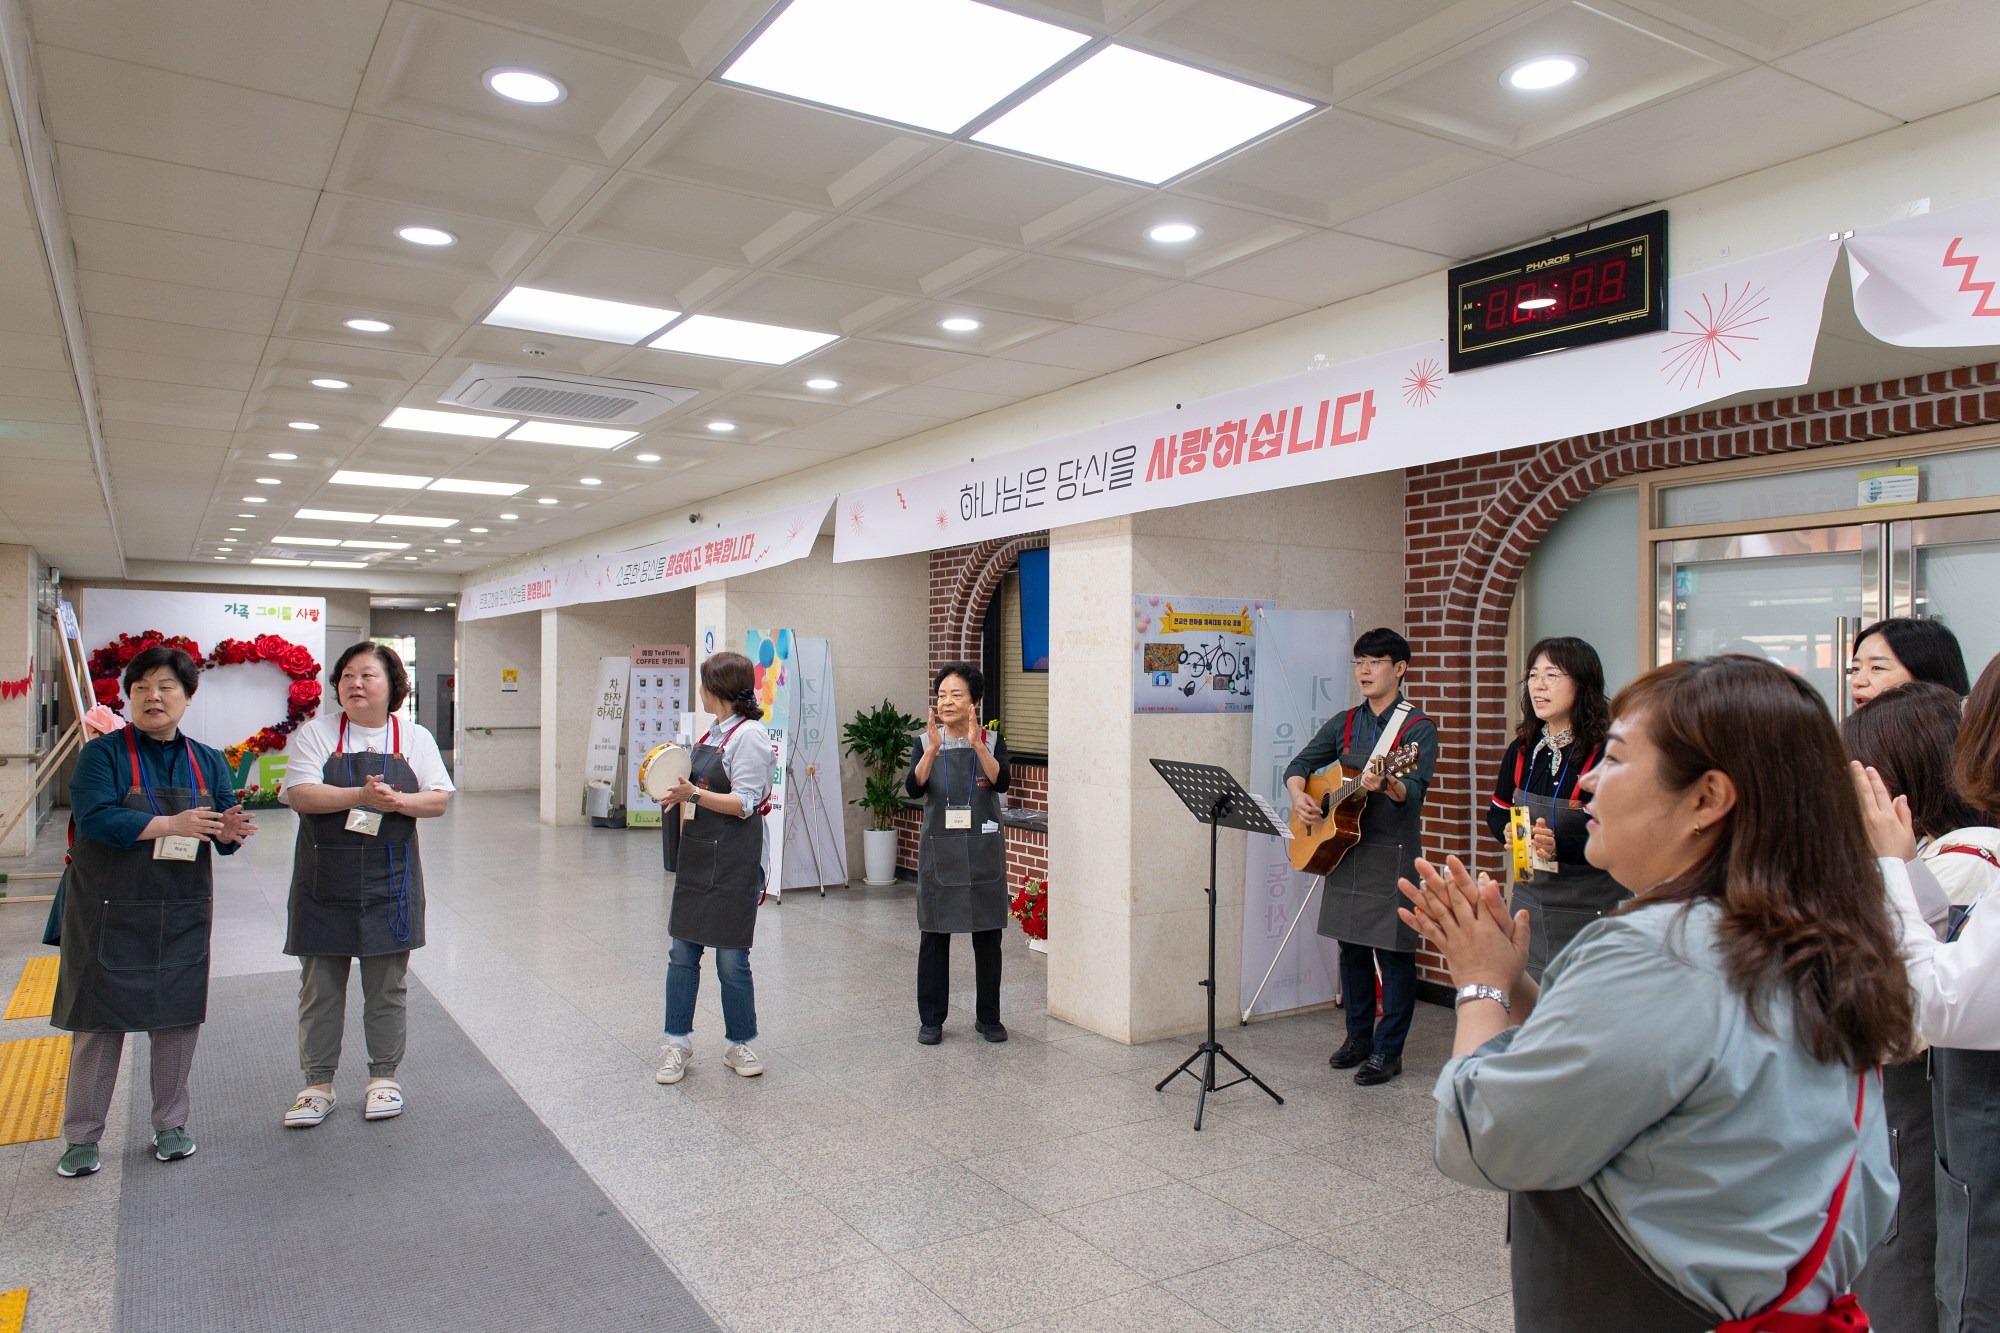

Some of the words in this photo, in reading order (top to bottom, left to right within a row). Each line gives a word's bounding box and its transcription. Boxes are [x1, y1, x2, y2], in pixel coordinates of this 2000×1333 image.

[1525, 252, 1571, 272] PHAROS
[1463, 302, 1473, 311] AM
[1463, 322, 1473, 332] PM
[959, 466, 1048, 522] 하나님은
[1055, 444, 1138, 502] 당신을
[1144, 389, 1377, 483] 사랑하십니다
[640, 556, 667, 583] 당신을
[665, 545, 702, 578] 환영하고
[704, 532, 755, 566] 축복합니다
[527, 579, 552, 601] 환영합니다
[224, 602, 251, 620] 가족
[295, 608, 321, 622] 사랑
[674, 657, 686, 665] 커피
[608, 678, 619, 692] 차
[603, 692, 622, 707] 한잔
[597, 706, 623, 720] 하세요
